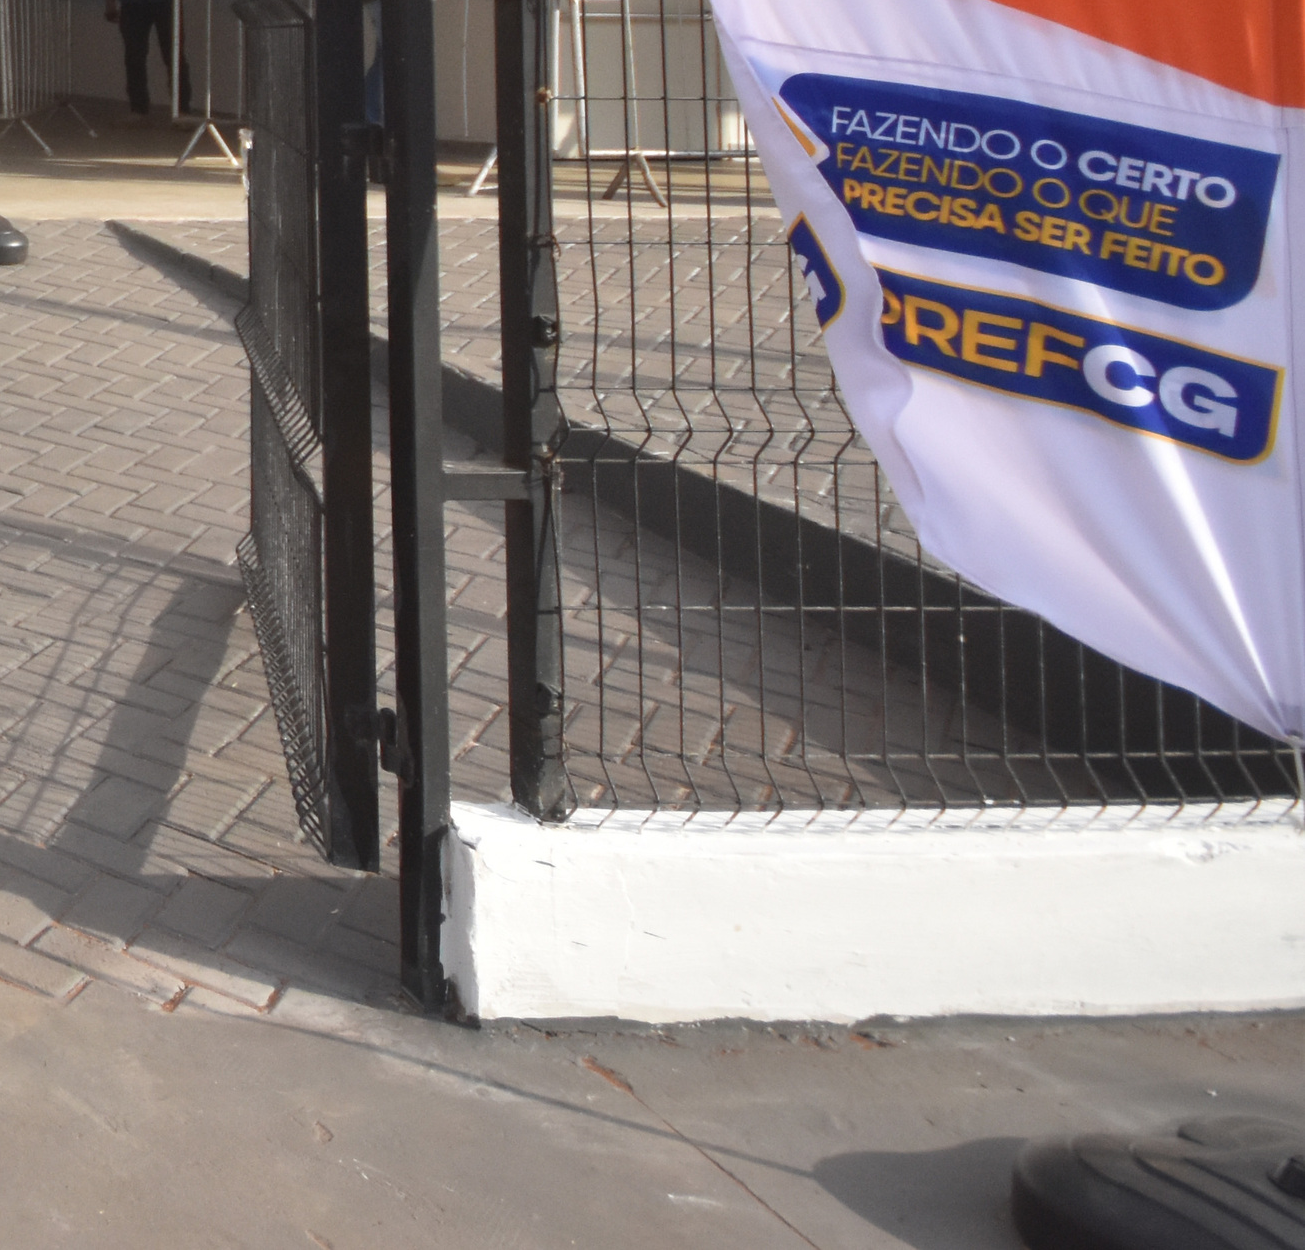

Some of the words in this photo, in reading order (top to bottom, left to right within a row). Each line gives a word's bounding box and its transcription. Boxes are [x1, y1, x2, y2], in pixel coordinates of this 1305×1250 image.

[831, 105, 1021, 160] FAZENDO
[1030, 139, 1068, 170] O
[1077, 150, 1237, 209] CERTO
[836, 141, 1023, 199] FAZENDO
[1032, 177, 1071, 209] O
[1078, 188, 1179, 238] QUE
[843, 177, 1007, 235] PRECISA
[1013, 210, 1092, 255] SER
[1099, 230, 1225, 286] FEITO
